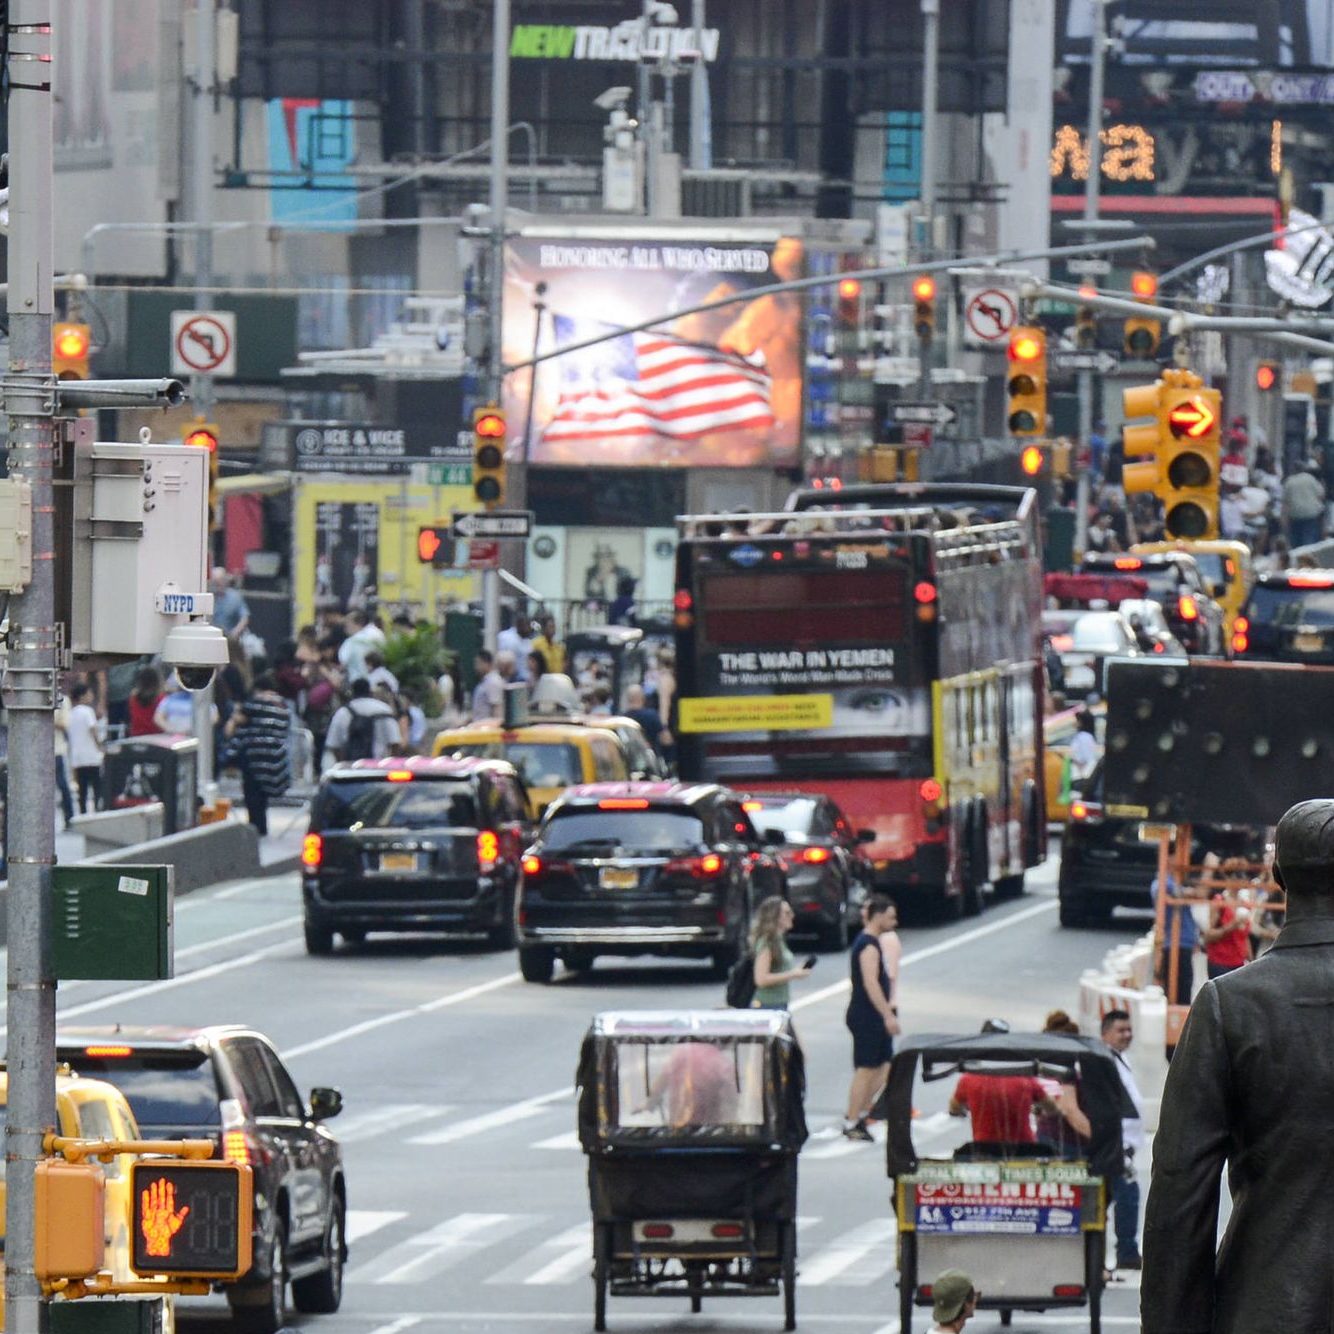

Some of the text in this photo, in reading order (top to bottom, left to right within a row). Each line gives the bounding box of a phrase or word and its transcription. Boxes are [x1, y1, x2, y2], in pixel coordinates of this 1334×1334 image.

[539, 244, 770, 272] HONORING ALL WHO SERVED
[163, 594, 195, 613] NYPD
[719, 648, 895, 671] THE WAR IN YEMEN
